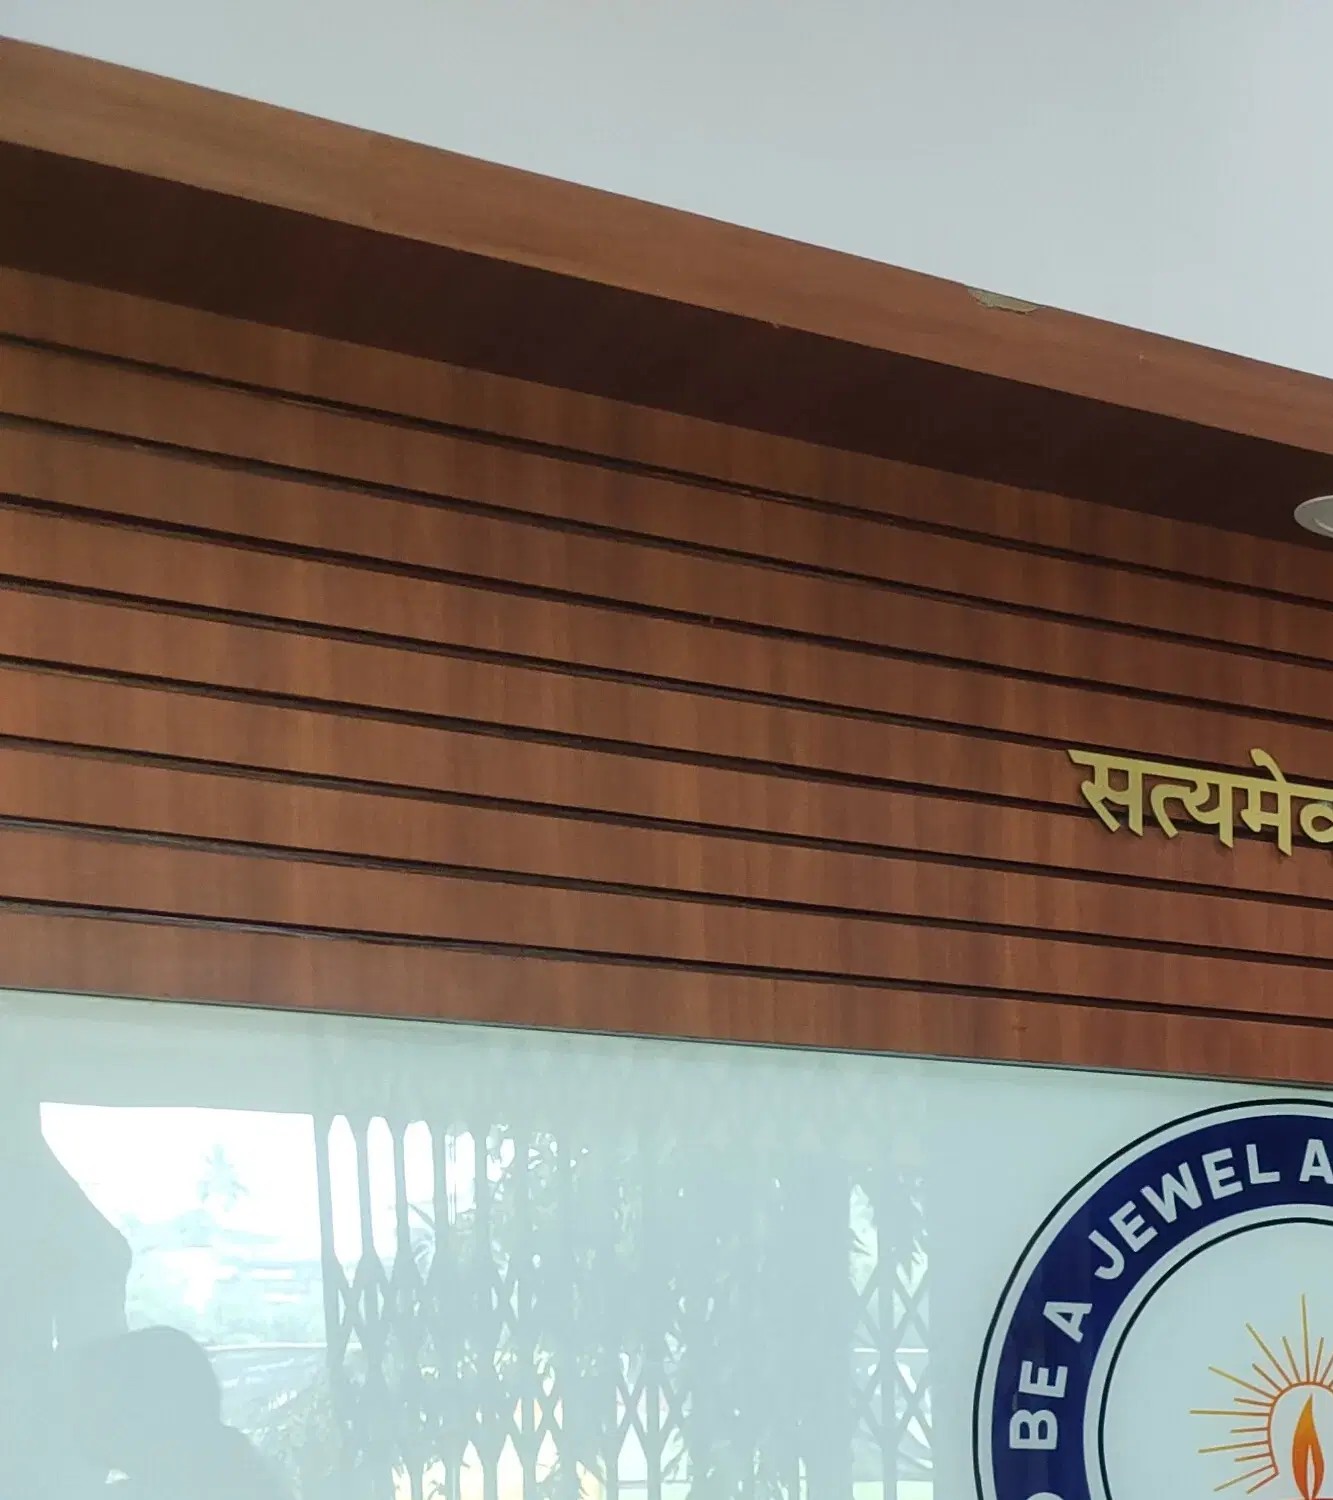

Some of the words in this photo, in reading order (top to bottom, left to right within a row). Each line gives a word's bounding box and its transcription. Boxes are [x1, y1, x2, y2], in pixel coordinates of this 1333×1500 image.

[1009, 1359, 1070, 1452] BE
[1044, 1299, 1093, 1344] A
[1093, 1143, 1281, 1281] JEWEL
